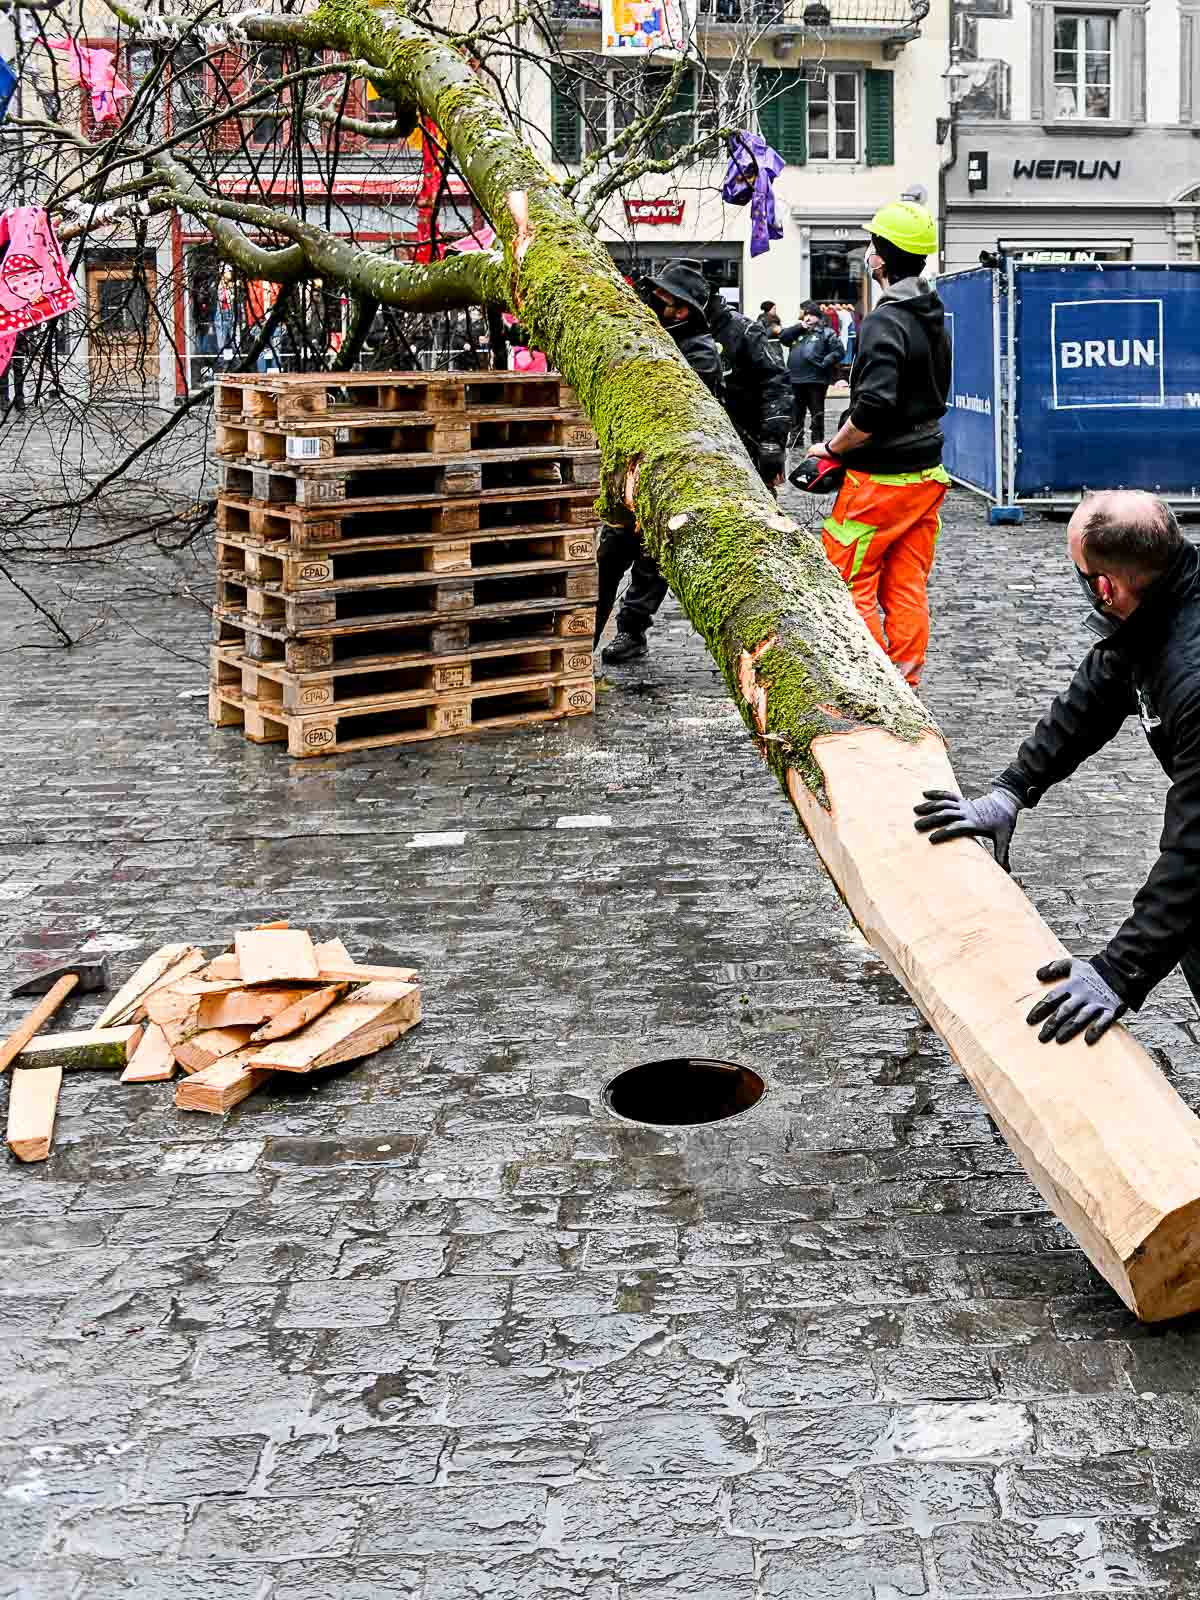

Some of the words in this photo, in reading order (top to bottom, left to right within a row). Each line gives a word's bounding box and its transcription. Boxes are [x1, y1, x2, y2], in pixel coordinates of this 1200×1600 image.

[1061, 339, 1155, 369] BRUN
[571, 544, 590, 555] EPAL
[303, 567, 325, 578] EPAL
[572, 657, 589, 667] EPAL
[572, 694, 589, 706] EPAL
[308, 730, 329, 743] EPAL
